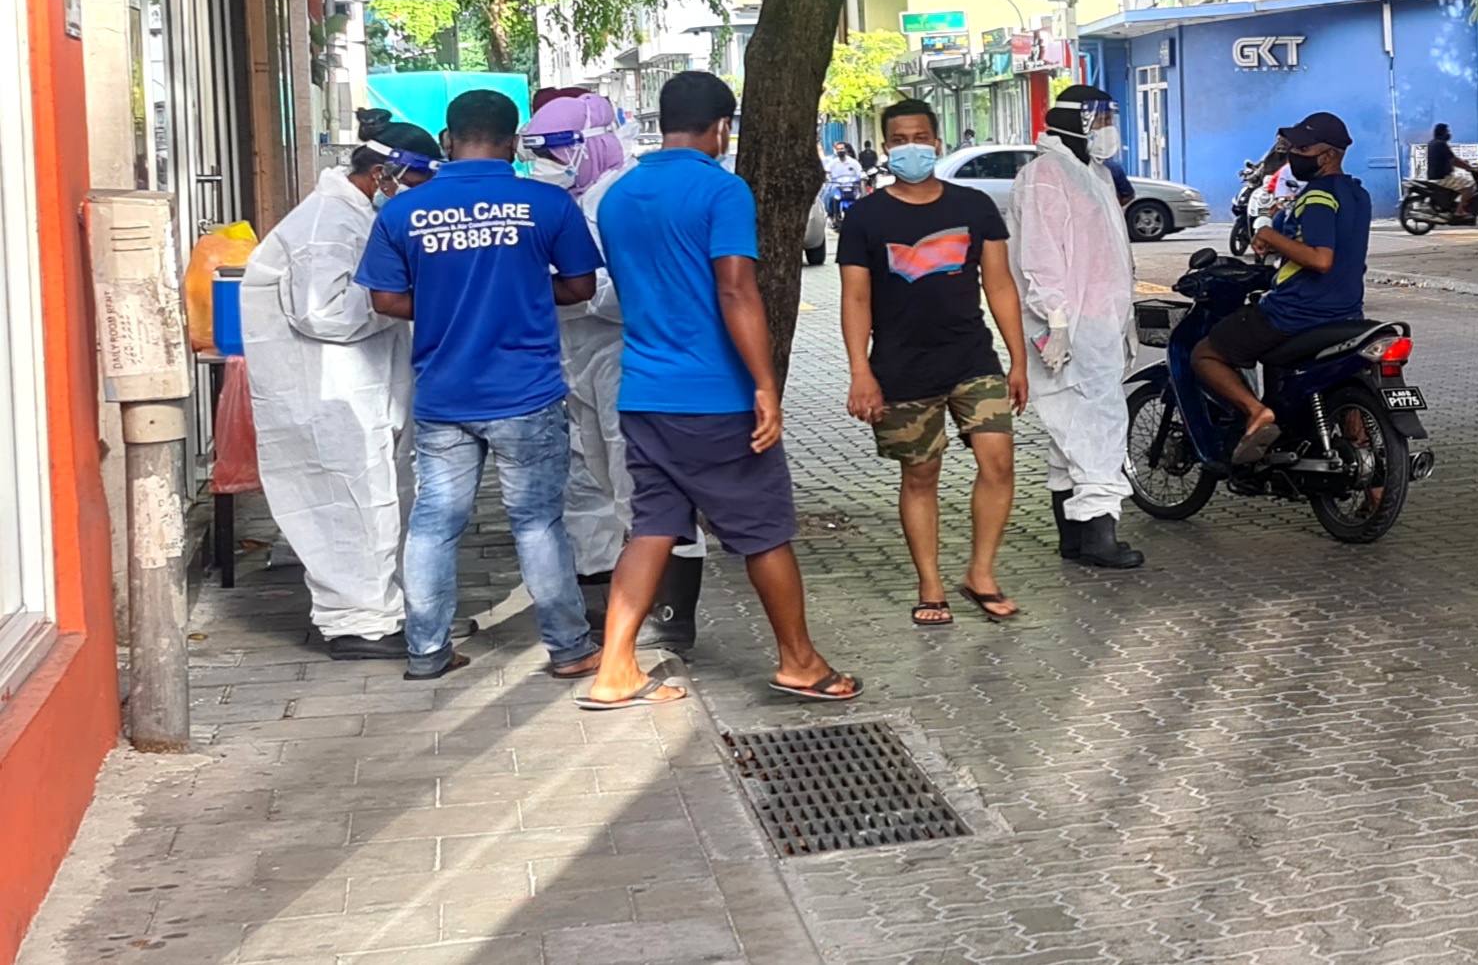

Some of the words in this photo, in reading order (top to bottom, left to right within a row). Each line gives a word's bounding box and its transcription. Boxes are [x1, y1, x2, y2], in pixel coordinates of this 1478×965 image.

[1232, 36, 1306, 67] GKT
[1234, 65, 1308, 73] PHARMACY
[410, 207, 473, 228] COOL
[473, 202, 531, 220] CARE
[422, 226, 519, 253] 9788873
[106, 316, 119, 342] ROOM
[110, 344, 123, 369] DAILY
